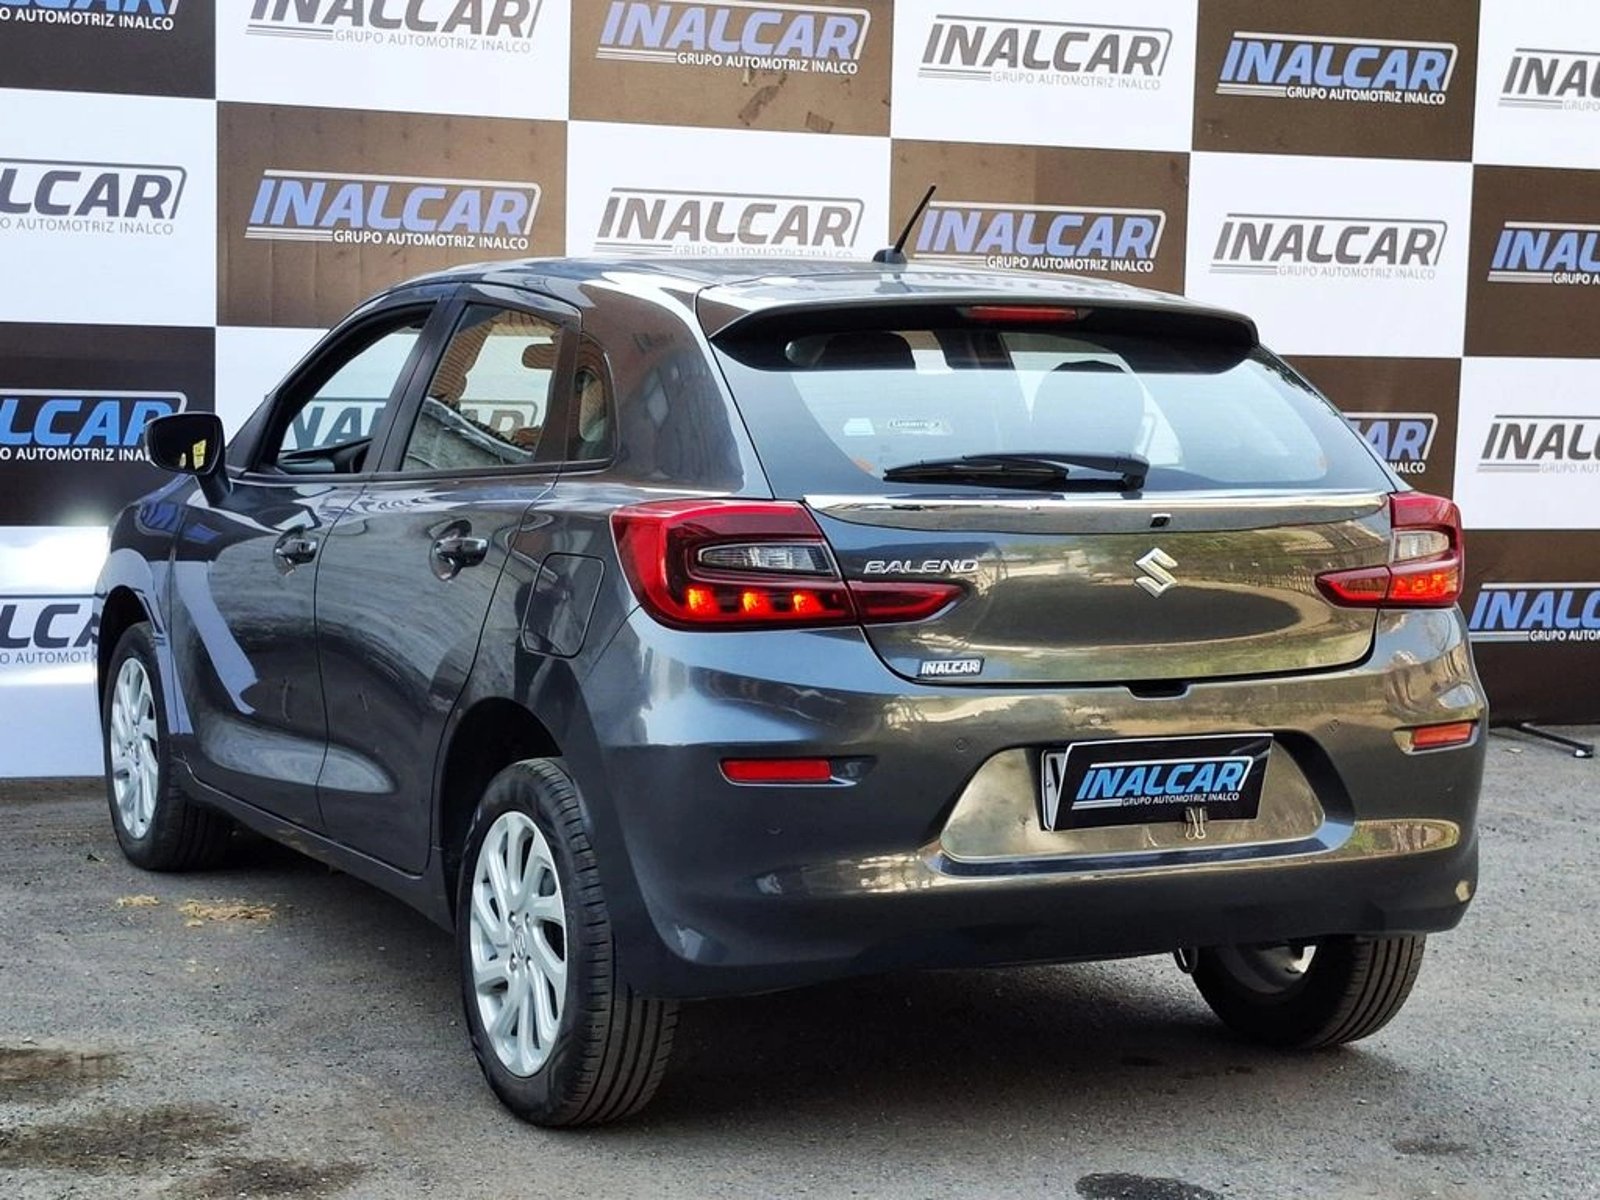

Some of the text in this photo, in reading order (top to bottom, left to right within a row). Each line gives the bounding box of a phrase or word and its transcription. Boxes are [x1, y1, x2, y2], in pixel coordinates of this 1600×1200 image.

[15, 9, 115, 27] AUTOMOTRIZ
[119, 15, 174, 30] INALCO
[336, 29, 531, 53] GRUPO AUTOMOTRIZ INALCO
[600, 2, 858, 59] INALCAR
[922, 23, 1161, 76] INALCAR
[677, 53, 858, 74] GRUPO AUTOMOTRIZ INALCO
[1220, 40, 1447, 90] INALCAR
[993, 72, 1161, 91] GRUPO AUTOMOTRIZ INALCO
[1287, 86, 1446, 105] GRUPO AUTOMOTRIZ INALCO
[250, 179, 529, 235] INALCAR
[16, 218, 115, 233] AUTOMOTRIZ
[119, 223, 174, 235] INALCO
[597, 196, 852, 247] INALCAR
[334, 229, 529, 250] GRUPO AUTOMOTRIZ INALCO
[916, 210, 1155, 259] INALCAR
[1213, 222, 1436, 266] INALCAR
[987, 256, 1154, 273] GRUPO AUTOMOTRIZ INALCO
[1279, 265, 1436, 281] GRUPO AUTOMOTRIZ INALCO
[1553, 272, 1590, 285] GRUPO
[1481, 423, 1600, 460] INAL
[15, 447, 115, 461] AUTOMOTRIZ
[1541, 463, 1578, 474] GRUPO
[863, 560, 979, 574] BALENO
[1530, 630, 1567, 642] GRUPO
[921, 659, 981, 675] INALCAR
[1076, 762, 1244, 800] INALCAR
[1122, 791, 1240, 806] GRUPO AUTOMOTRIZ INALCO
